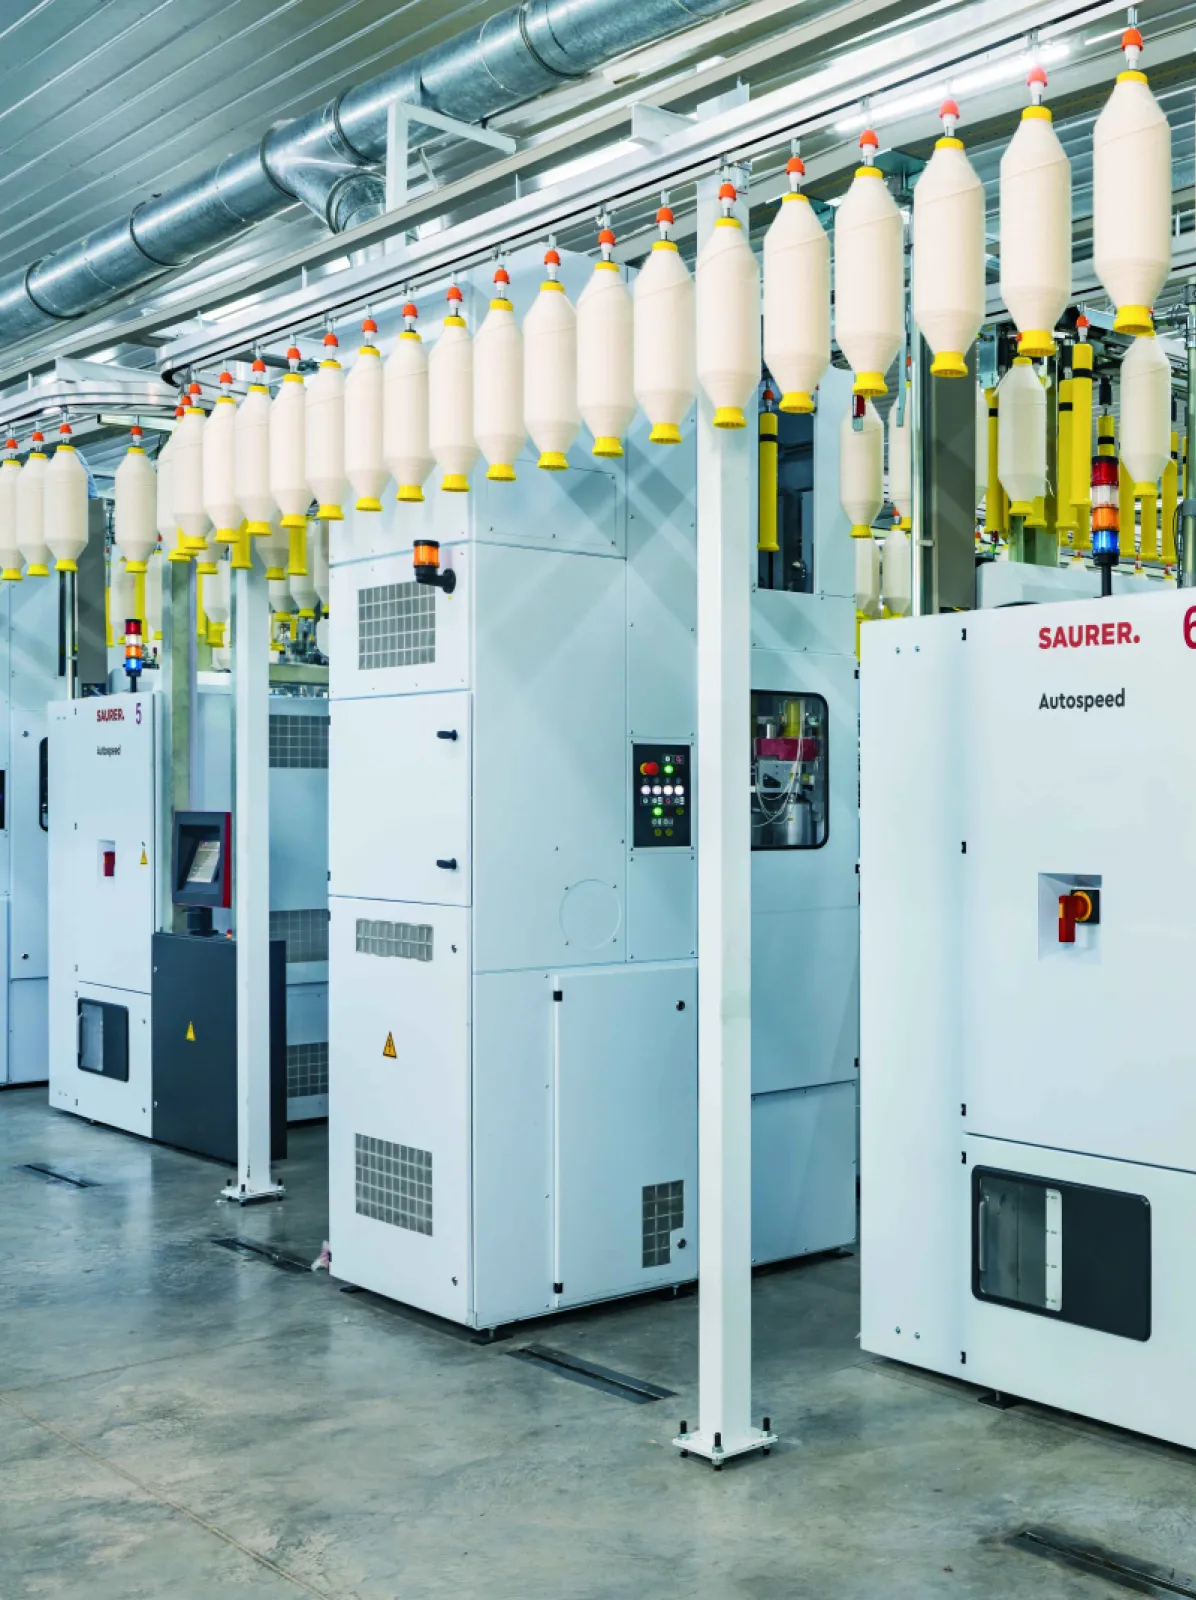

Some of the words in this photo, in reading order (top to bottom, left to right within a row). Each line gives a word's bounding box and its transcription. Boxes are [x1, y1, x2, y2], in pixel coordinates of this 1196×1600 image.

[1038, 621, 1141, 649] SAURER.
[1038, 687, 1126, 712] Autospeed
[135, 702, 142, 725] 5
